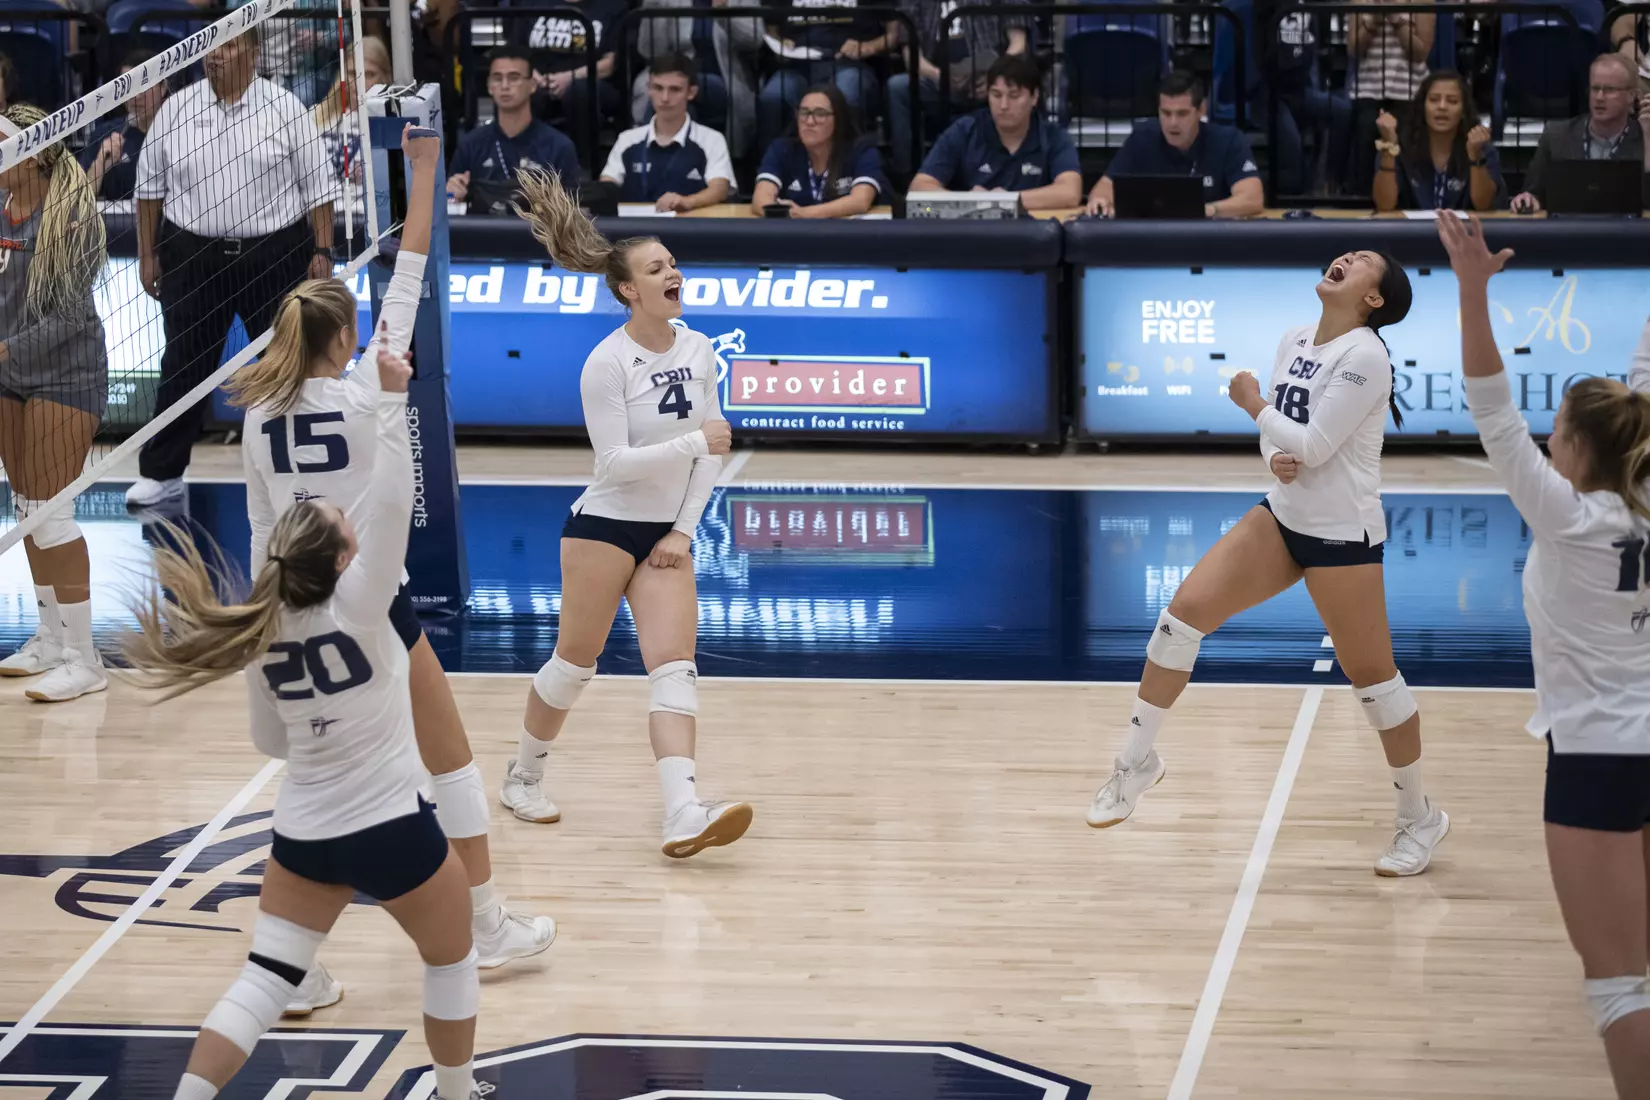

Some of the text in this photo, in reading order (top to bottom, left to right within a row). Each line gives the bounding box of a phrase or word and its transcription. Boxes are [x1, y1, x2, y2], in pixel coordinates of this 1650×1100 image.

[241, 2, 258, 28] CBU
[158, 24, 219, 76] #LANCEUP
[113, 74, 133, 101] CBU
[16, 99, 86, 157] #LANCEUP
[523, 267, 599, 314] by
[1141, 299, 1216, 319] ENJOY
[1141, 319, 1216, 344] FREE
[1288, 355, 1323, 380] CBU
[1342, 370, 1368, 387] WAC
[741, 368, 908, 399] provider
[1097, 384, 1150, 397] Breakfast
[658, 383, 693, 421] 4
[1274, 382, 1311, 426] 18
[741, 415, 905, 431] contract food service
[261, 410, 350, 474] 15
[406, 406, 429, 528] sports imports
[262, 630, 374, 701] 20
